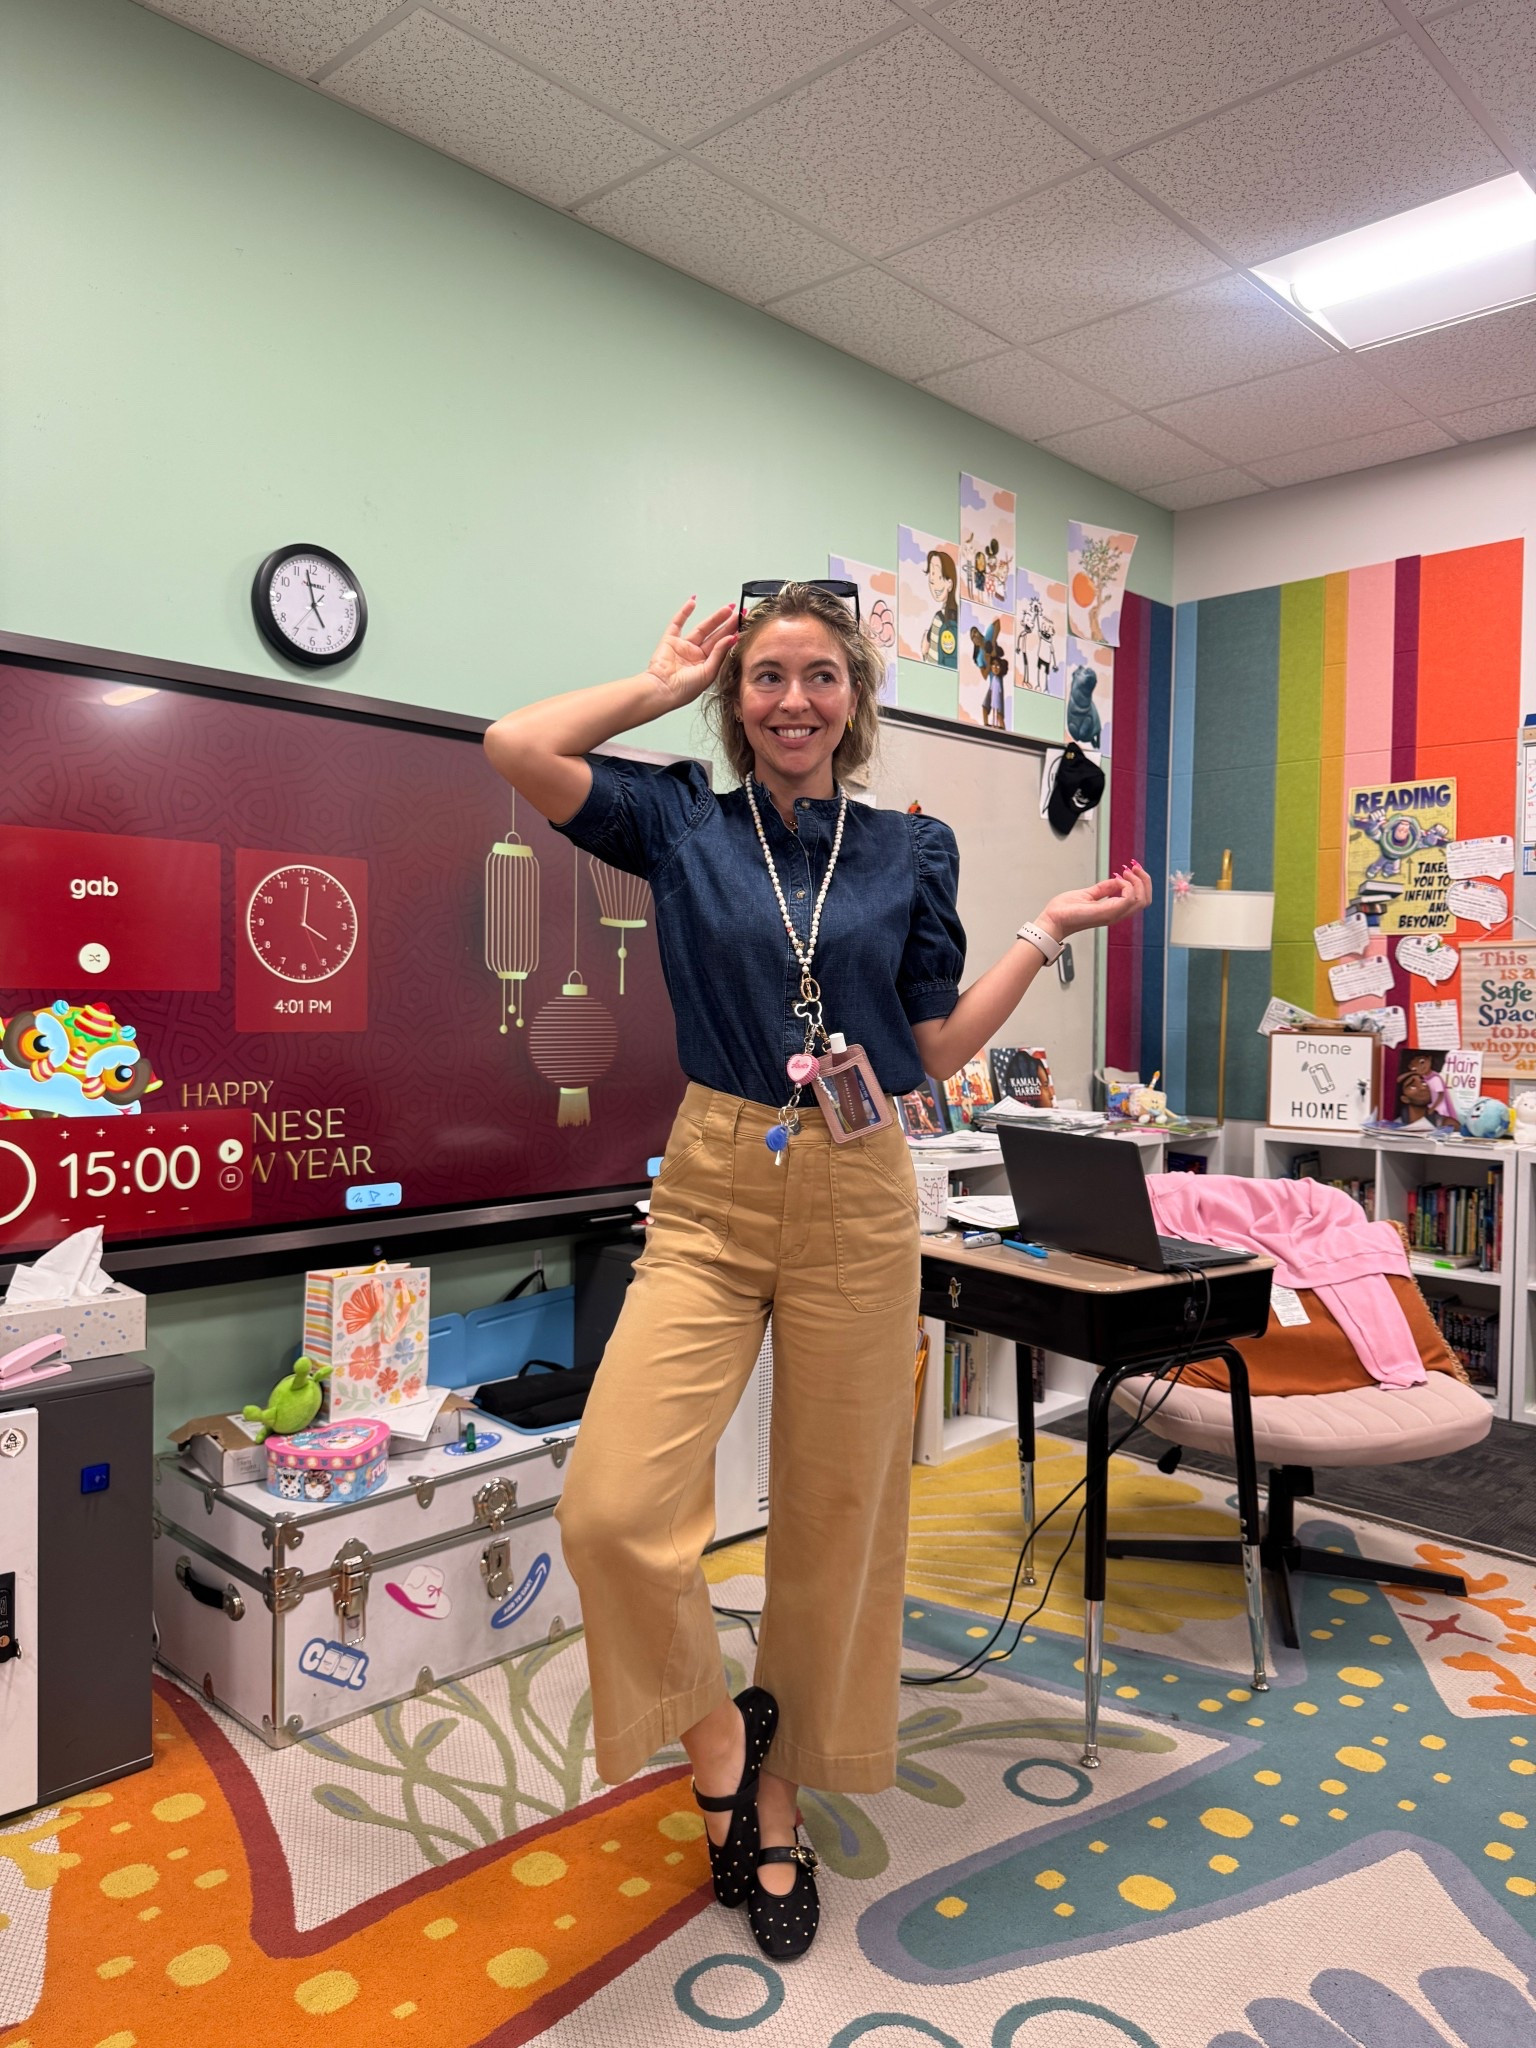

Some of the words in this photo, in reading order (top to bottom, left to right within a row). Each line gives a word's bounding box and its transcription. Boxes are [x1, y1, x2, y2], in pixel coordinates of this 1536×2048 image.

[293, 565, 300, 577] 11
[309, 564, 318, 576] 12
[281, 576, 291, 588] 10
[280, 612, 287, 623] 8
[344, 608, 350, 619] 3
[292, 627, 300, 637] 7
[338, 625, 344, 636] 4
[309, 636, 316, 647] 6
[326, 635, 332, 646] 5
[1354, 785, 1451, 814] READING
[70, 875, 119, 899] gab
[279, 881, 288, 889] 11
[299, 877, 309, 885] 12
[1413, 876, 1436, 888] YOU
[1437, 875, 1451, 887] TO
[321, 884, 327, 892] 1
[263, 896, 273, 905] 10
[336, 901, 343, 909] 2
[258, 918, 265, 926] 9
[1398, 914, 1450, 929] BEYOND!
[264, 940, 271, 949] 8
[280, 956, 287, 964] 7
[1479, 950, 1528, 967] This
[301, 963, 307, 971] 6
[1500, 968, 1519, 980] is
[1481, 979, 1533, 1008] Safe
[273, 999, 304, 1014] 4:01
[309, 999, 332, 1014] PM
[1478, 1004, 1536, 1027] Spac
[1491, 1025, 1514, 1039] to
[1296, 1040, 1352, 1056] Phone
[1470, 1039, 1512, 1053] who
[1503, 1041, 1536, 1062] yo
[1446, 1055, 1479, 1074] Hair
[1515, 1058, 1536, 1071] ar
[1010, 1077, 1042, 1087] KAMALA
[1444, 1074, 1477, 1090] Love
[182, 1080, 275, 1108] HAPPY
[1014, 1086, 1042, 1097] HARRIS
[1291, 1100, 1349, 1120] HOME
[251, 1107, 346, 1144] NESE
[286, 1145, 376, 1181] YEAR
[58, 1144, 201, 1200] 15:00
